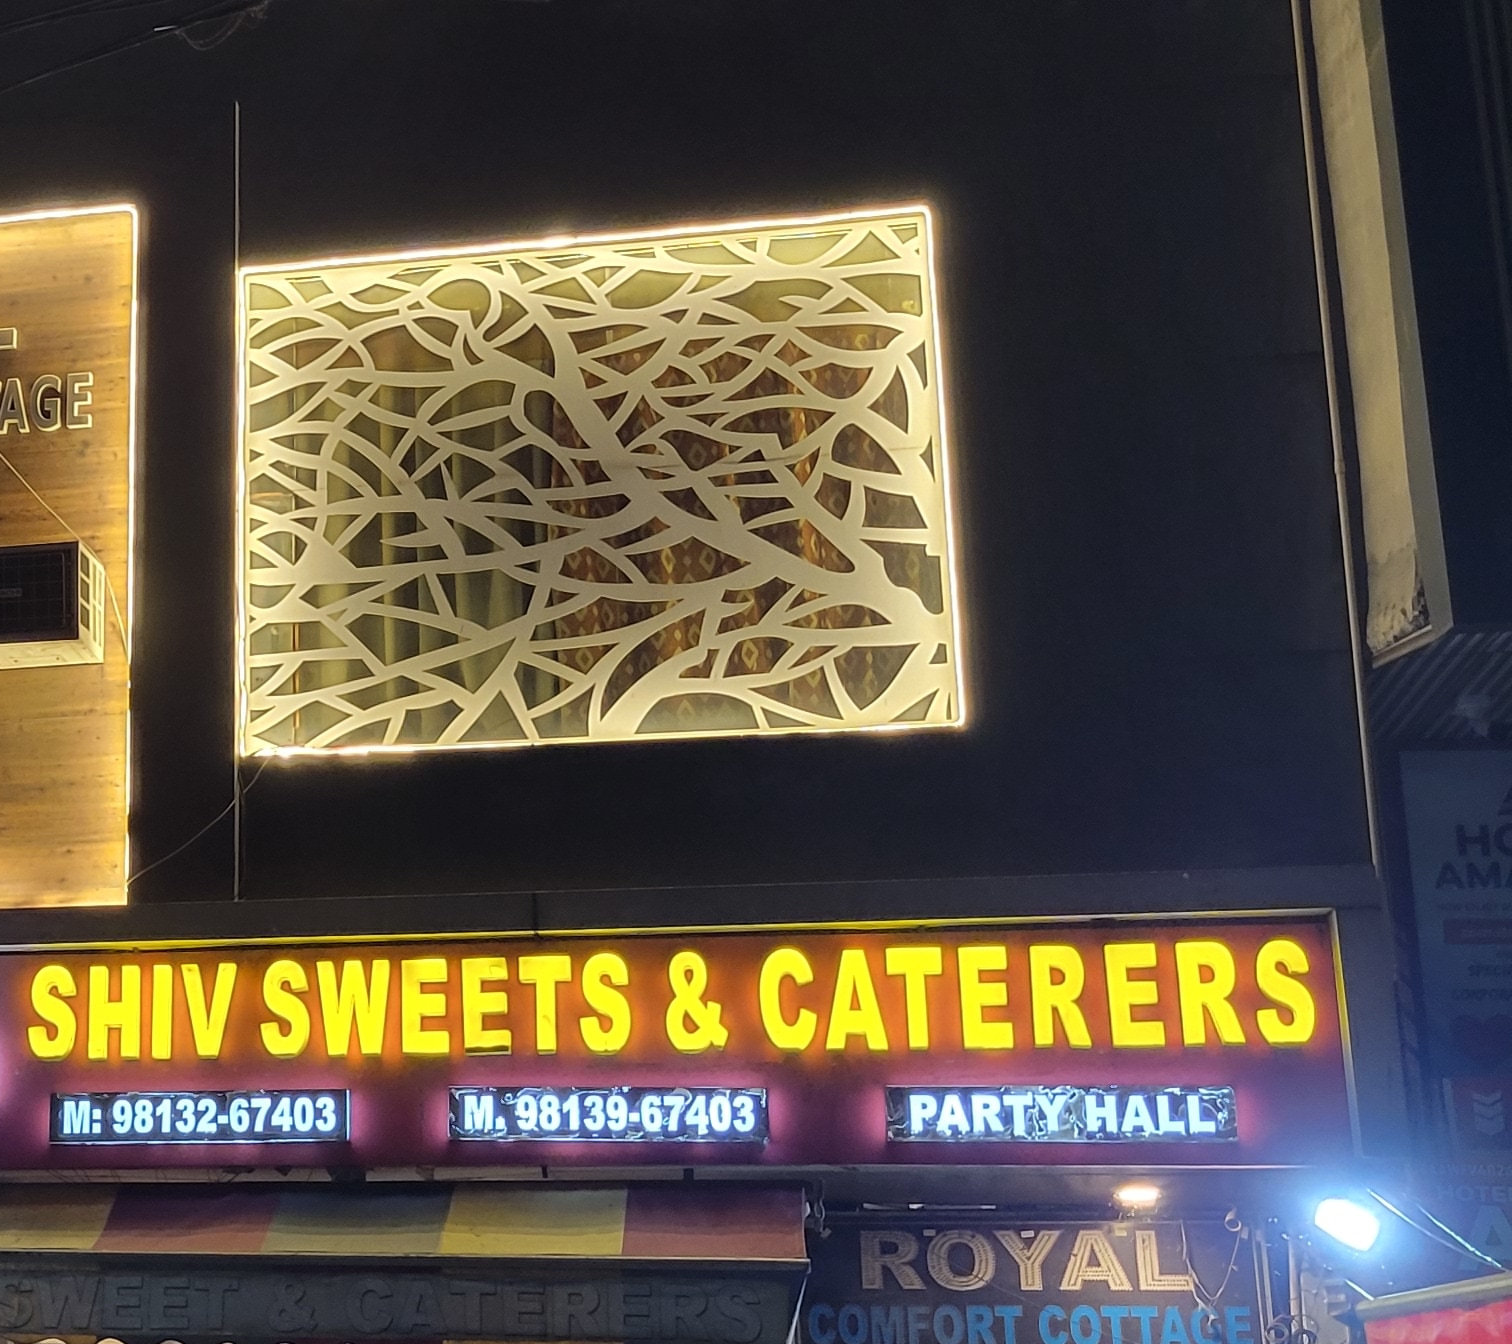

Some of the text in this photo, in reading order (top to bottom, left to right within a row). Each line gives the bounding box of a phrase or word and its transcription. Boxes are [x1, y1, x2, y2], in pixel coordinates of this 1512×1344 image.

[26, 938, 1318, 1062] SHIV SWEETS & CATERERS
[62, 1096, 338, 1135] M: 98132-67403
[514, 1092, 756, 1134] 98139-67403
[908, 1093, 1218, 1135] PARTY HALL
[858, 1227, 1195, 1294] ROYAL
[268, 1277, 318, 1335] &
